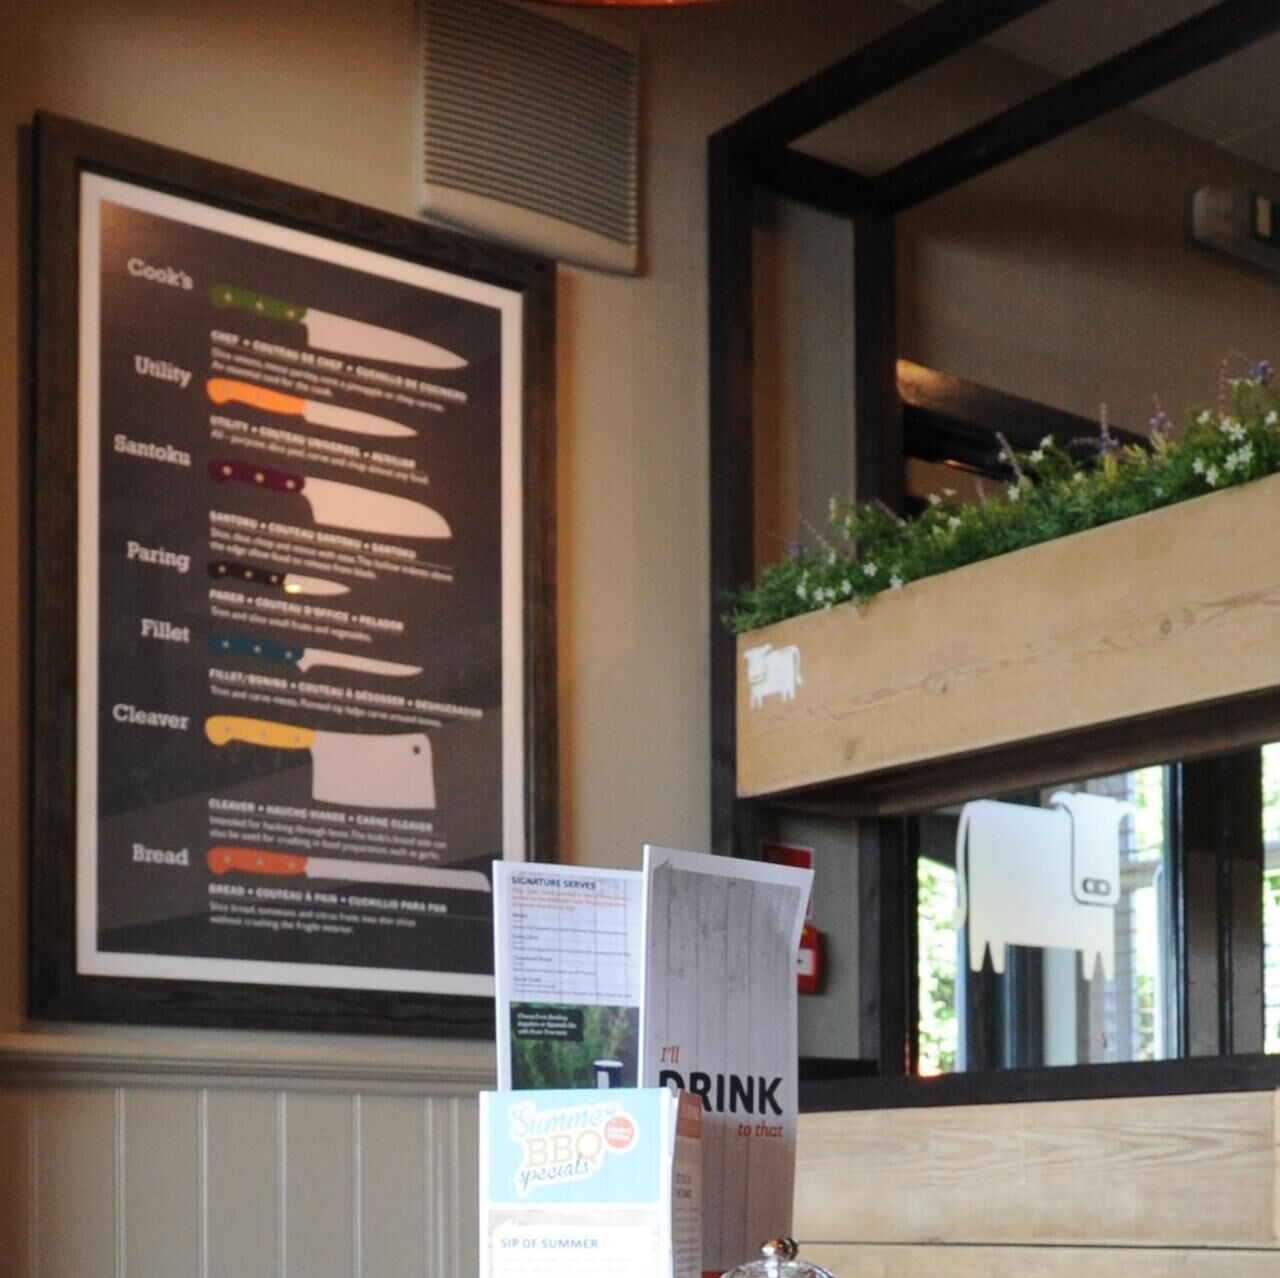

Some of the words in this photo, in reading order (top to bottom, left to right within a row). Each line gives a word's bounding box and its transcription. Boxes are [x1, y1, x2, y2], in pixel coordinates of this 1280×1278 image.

[127, 257, 193, 291] Cook's
[134, 355, 192, 388] Utility
[114, 434, 191, 467] Santoku
[127, 542, 190, 573] Paring
[140, 618, 189, 643] Fillet
[112, 703, 189, 731] Cleaver
[132, 843, 189, 867] Bread
[511, 876, 560, 888] SIGNATURE
[563, 880, 597, 890] SERVES
[660, 1045, 681, 1063] I'll
[659, 1069, 784, 1116] DRINK
[511, 1104, 618, 1138] Summer
[737, 1123, 752, 1137] to
[755, 1120, 783, 1138] that
[526, 1129, 602, 1168] BBQ
[519, 1151, 590, 1192] specials
[500, 1238, 520, 1249] SIP
[522, 1238, 537, 1249] OF
[541, 1238, 599, 1249] SUMMER
